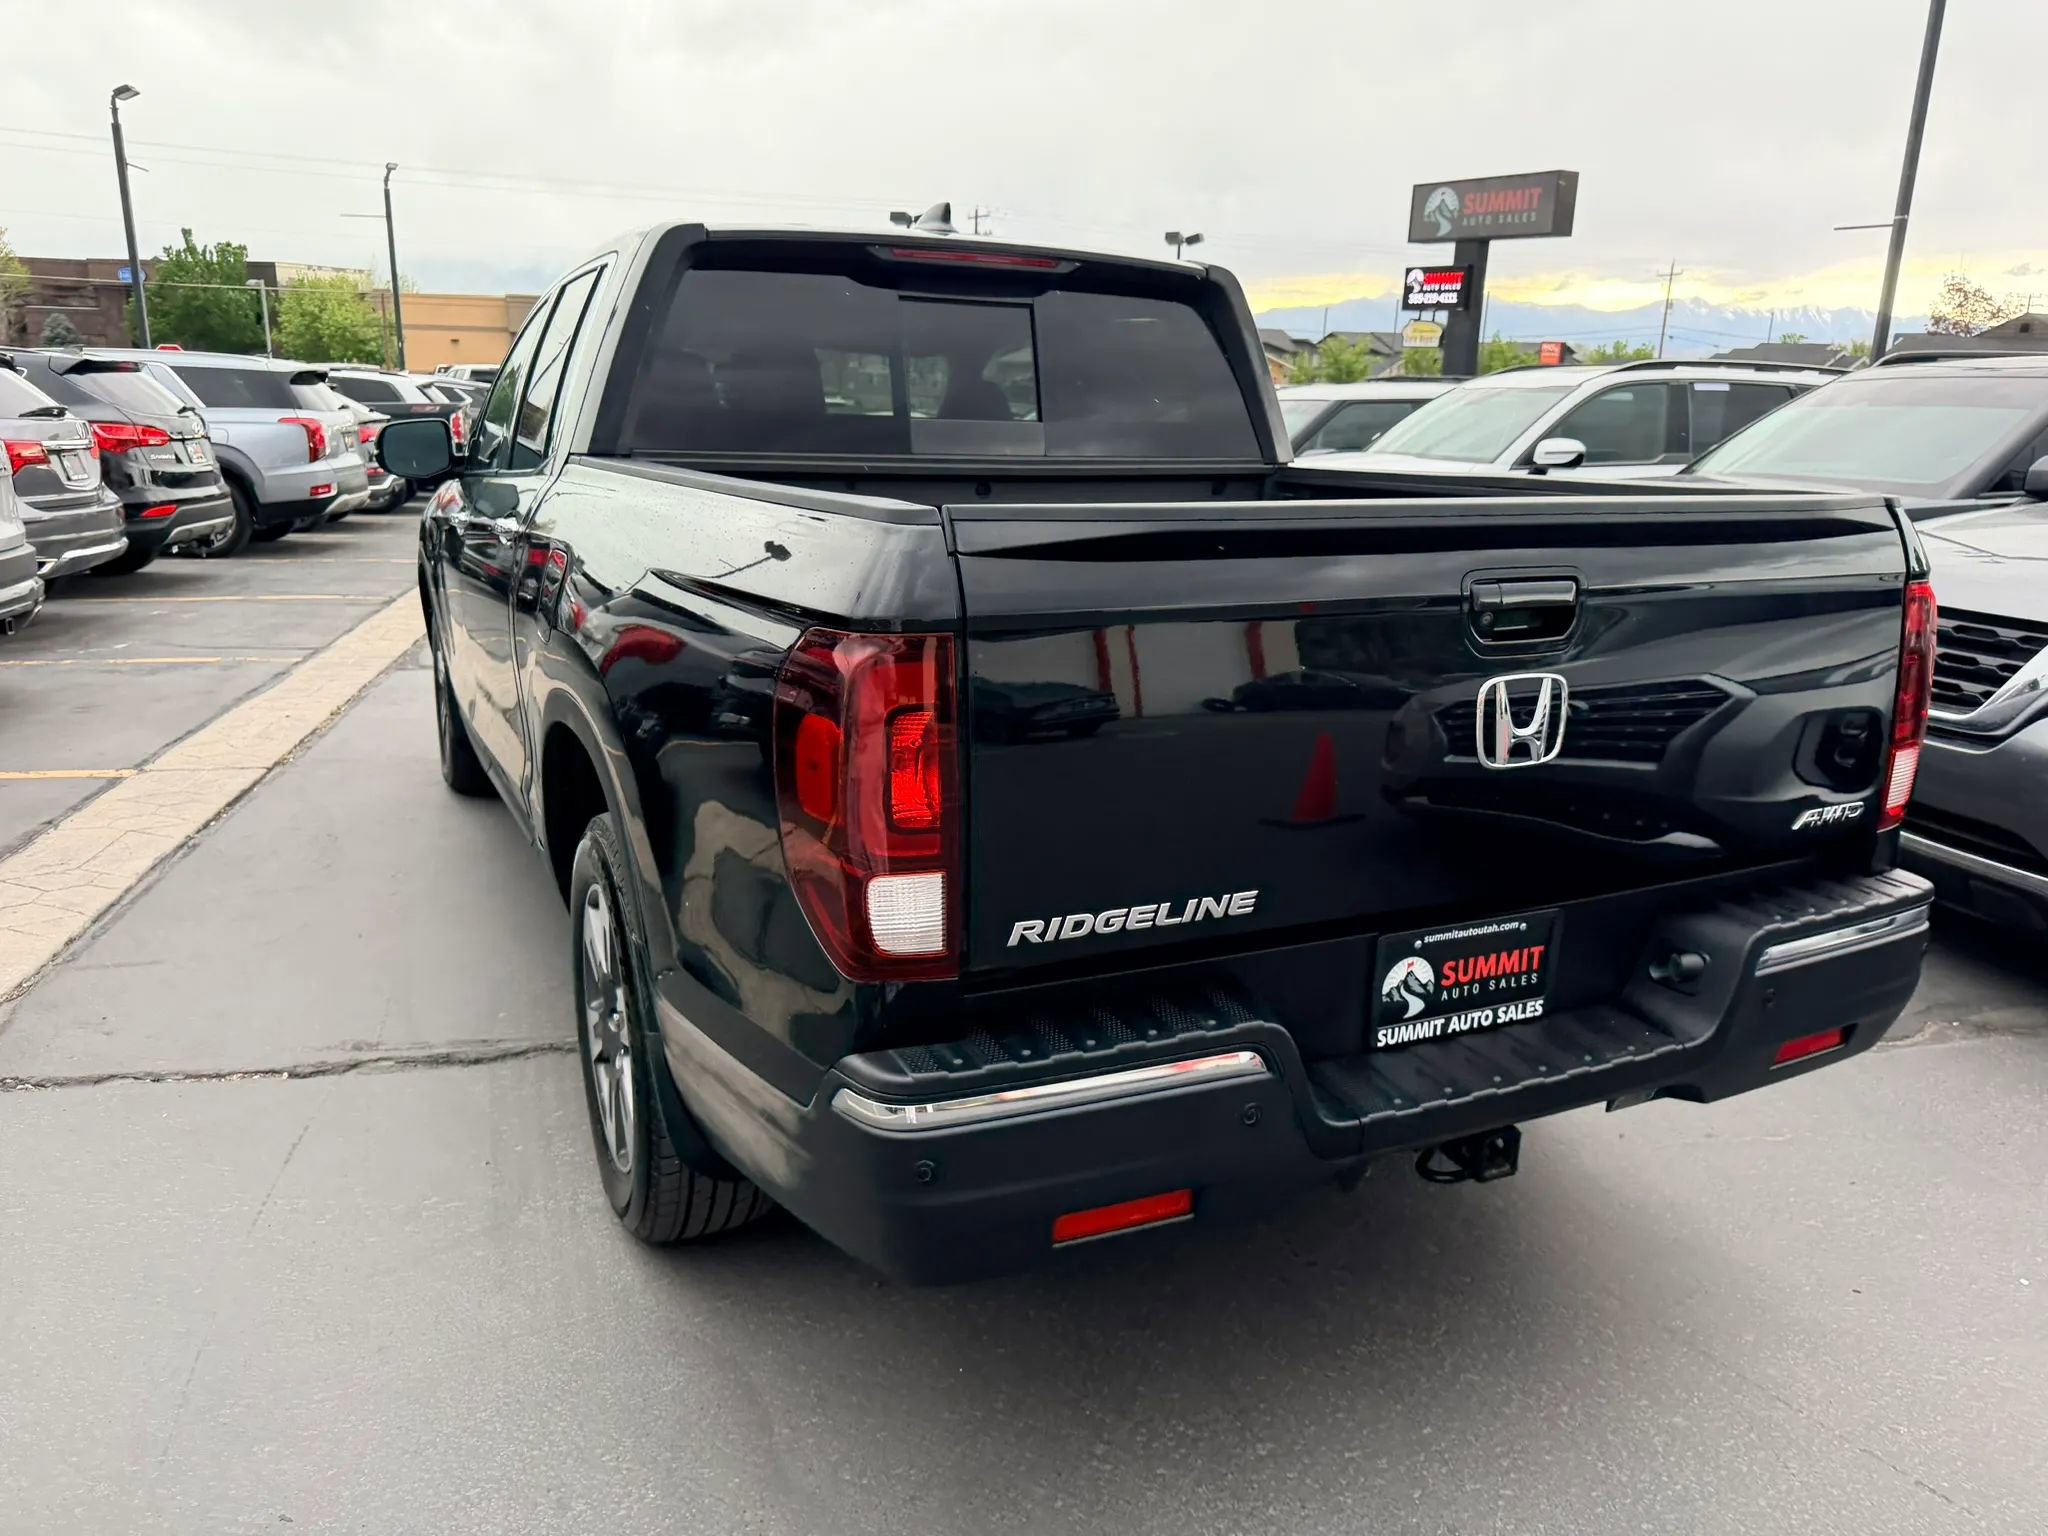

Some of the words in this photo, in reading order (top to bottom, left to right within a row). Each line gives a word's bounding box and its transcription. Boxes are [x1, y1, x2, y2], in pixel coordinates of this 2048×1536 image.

[1462, 187, 1542, 215] SUMMIT
[1462, 214, 1492, 226] AUTO
[1498, 211, 1537, 224] SALES
[1006, 889, 1259, 947] RIDGELINE
[1424, 921, 1519, 943] summitautoutah.com
[1440, 945, 1545, 987] SUMMIT
[1441, 984, 1480, 1001] AUTO
[1489, 972, 1538, 991] SALES
[1377, 1018, 1445, 1047] SUMMIT
[1448, 1009, 1493, 1033] AUTO
[1497, 1000, 1544, 1024] SALES
